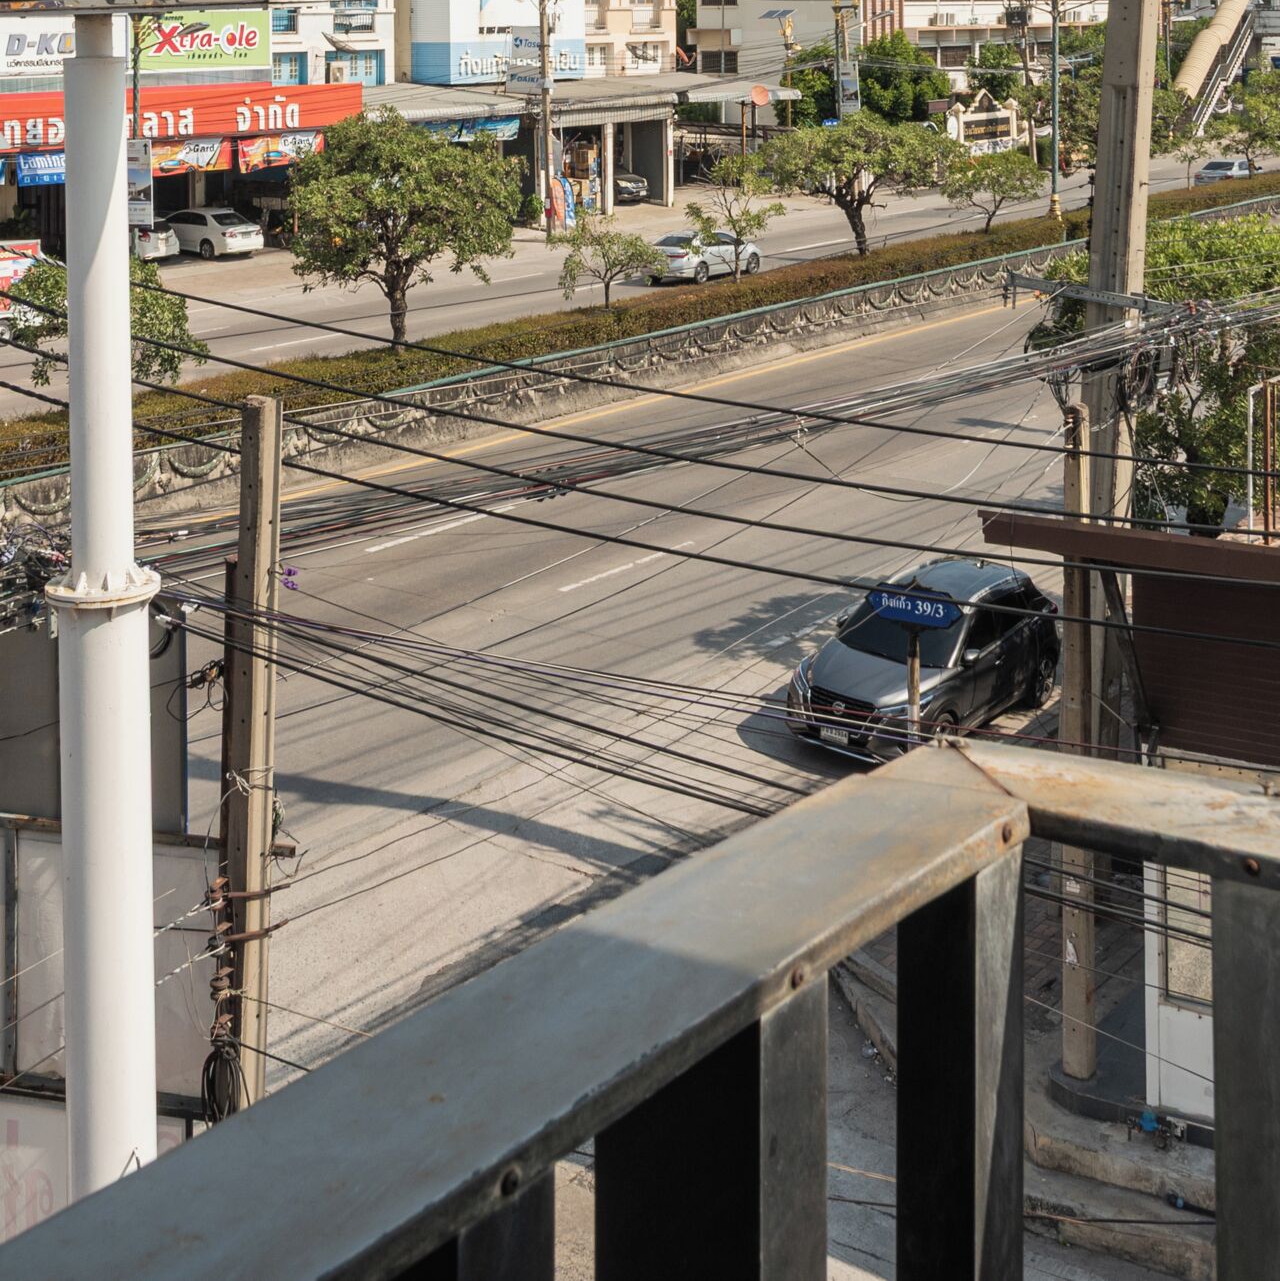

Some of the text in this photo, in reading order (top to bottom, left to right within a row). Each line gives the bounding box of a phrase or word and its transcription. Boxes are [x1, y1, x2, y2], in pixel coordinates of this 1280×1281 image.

[517, 75, 539, 84] DAIKI
[235, 94, 301, 132] จำกัด
[914, 600, 944, 618] 39/3
